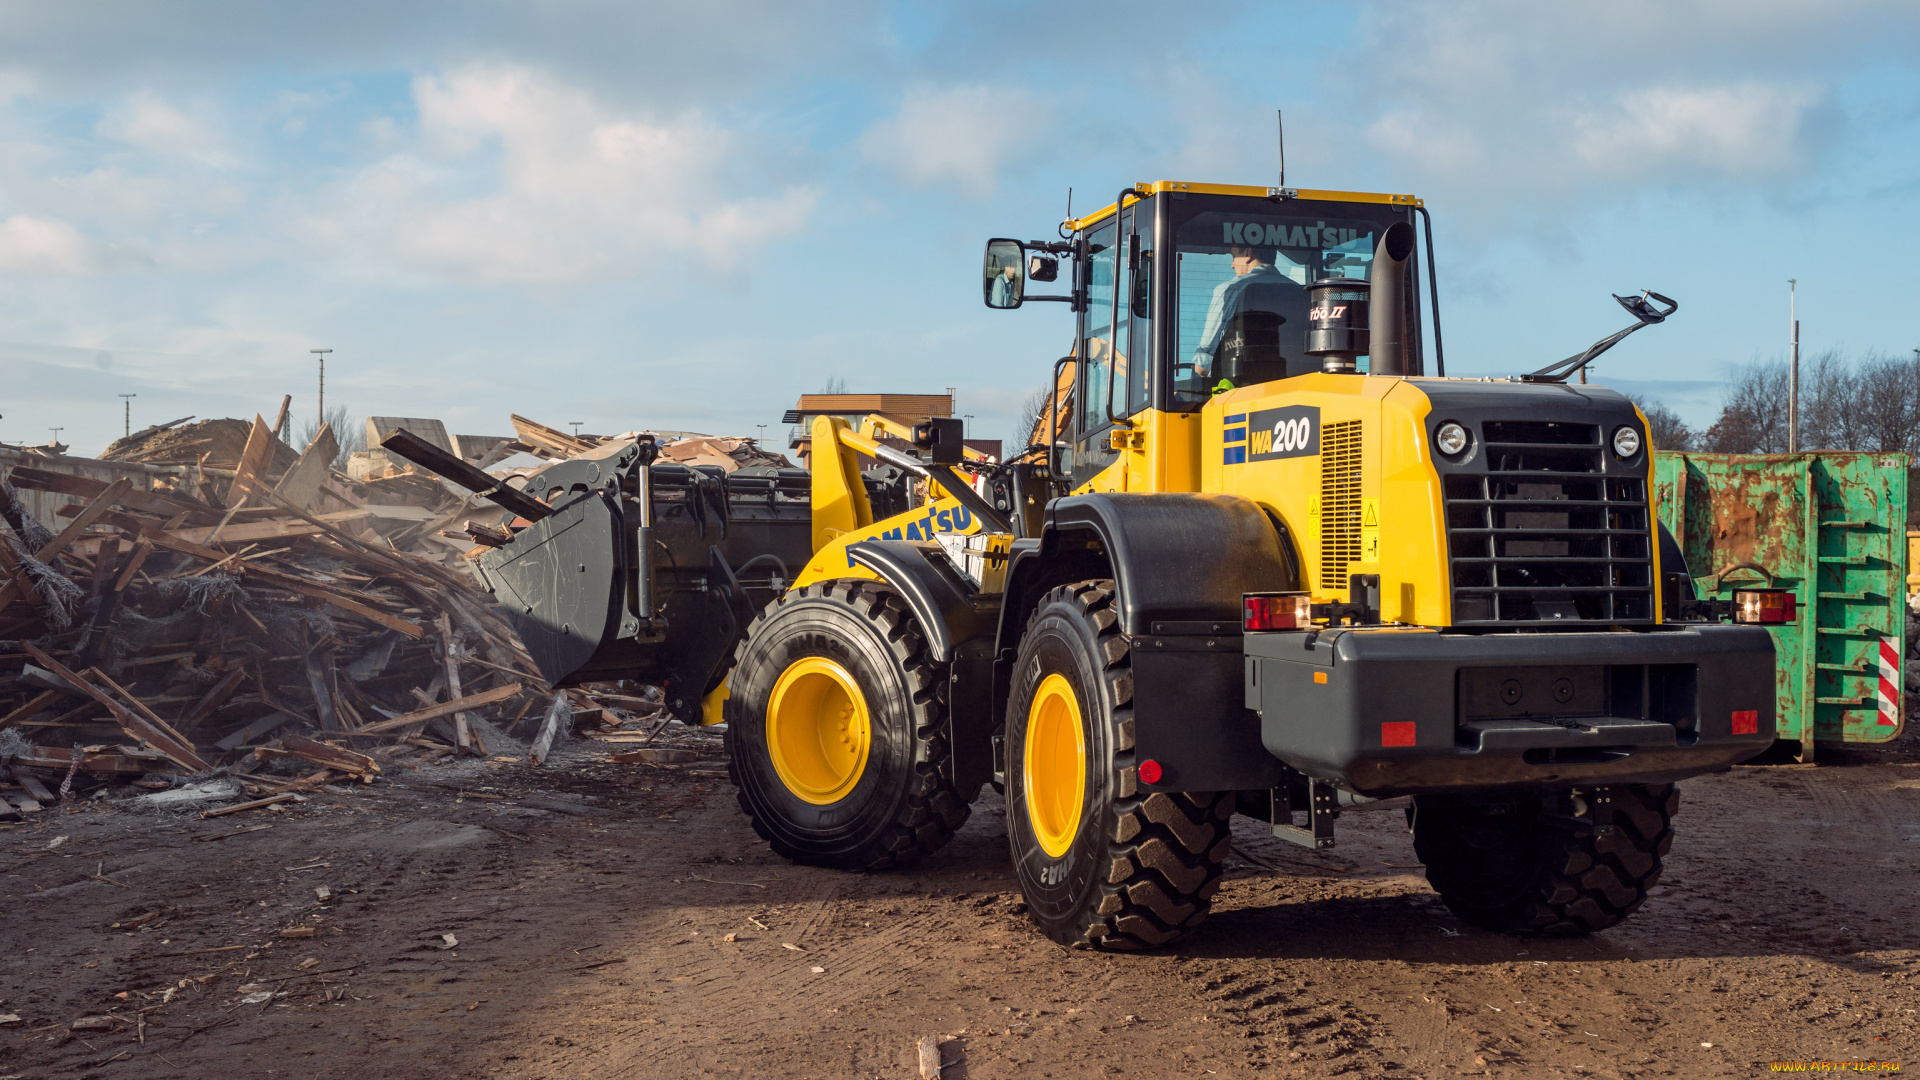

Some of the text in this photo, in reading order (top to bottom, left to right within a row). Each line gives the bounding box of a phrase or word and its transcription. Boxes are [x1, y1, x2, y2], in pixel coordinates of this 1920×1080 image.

[1223, 220, 1357, 250] KOMATSU
[1251, 416, 1311, 455] WA200
[845, 505, 972, 568] MATSU
